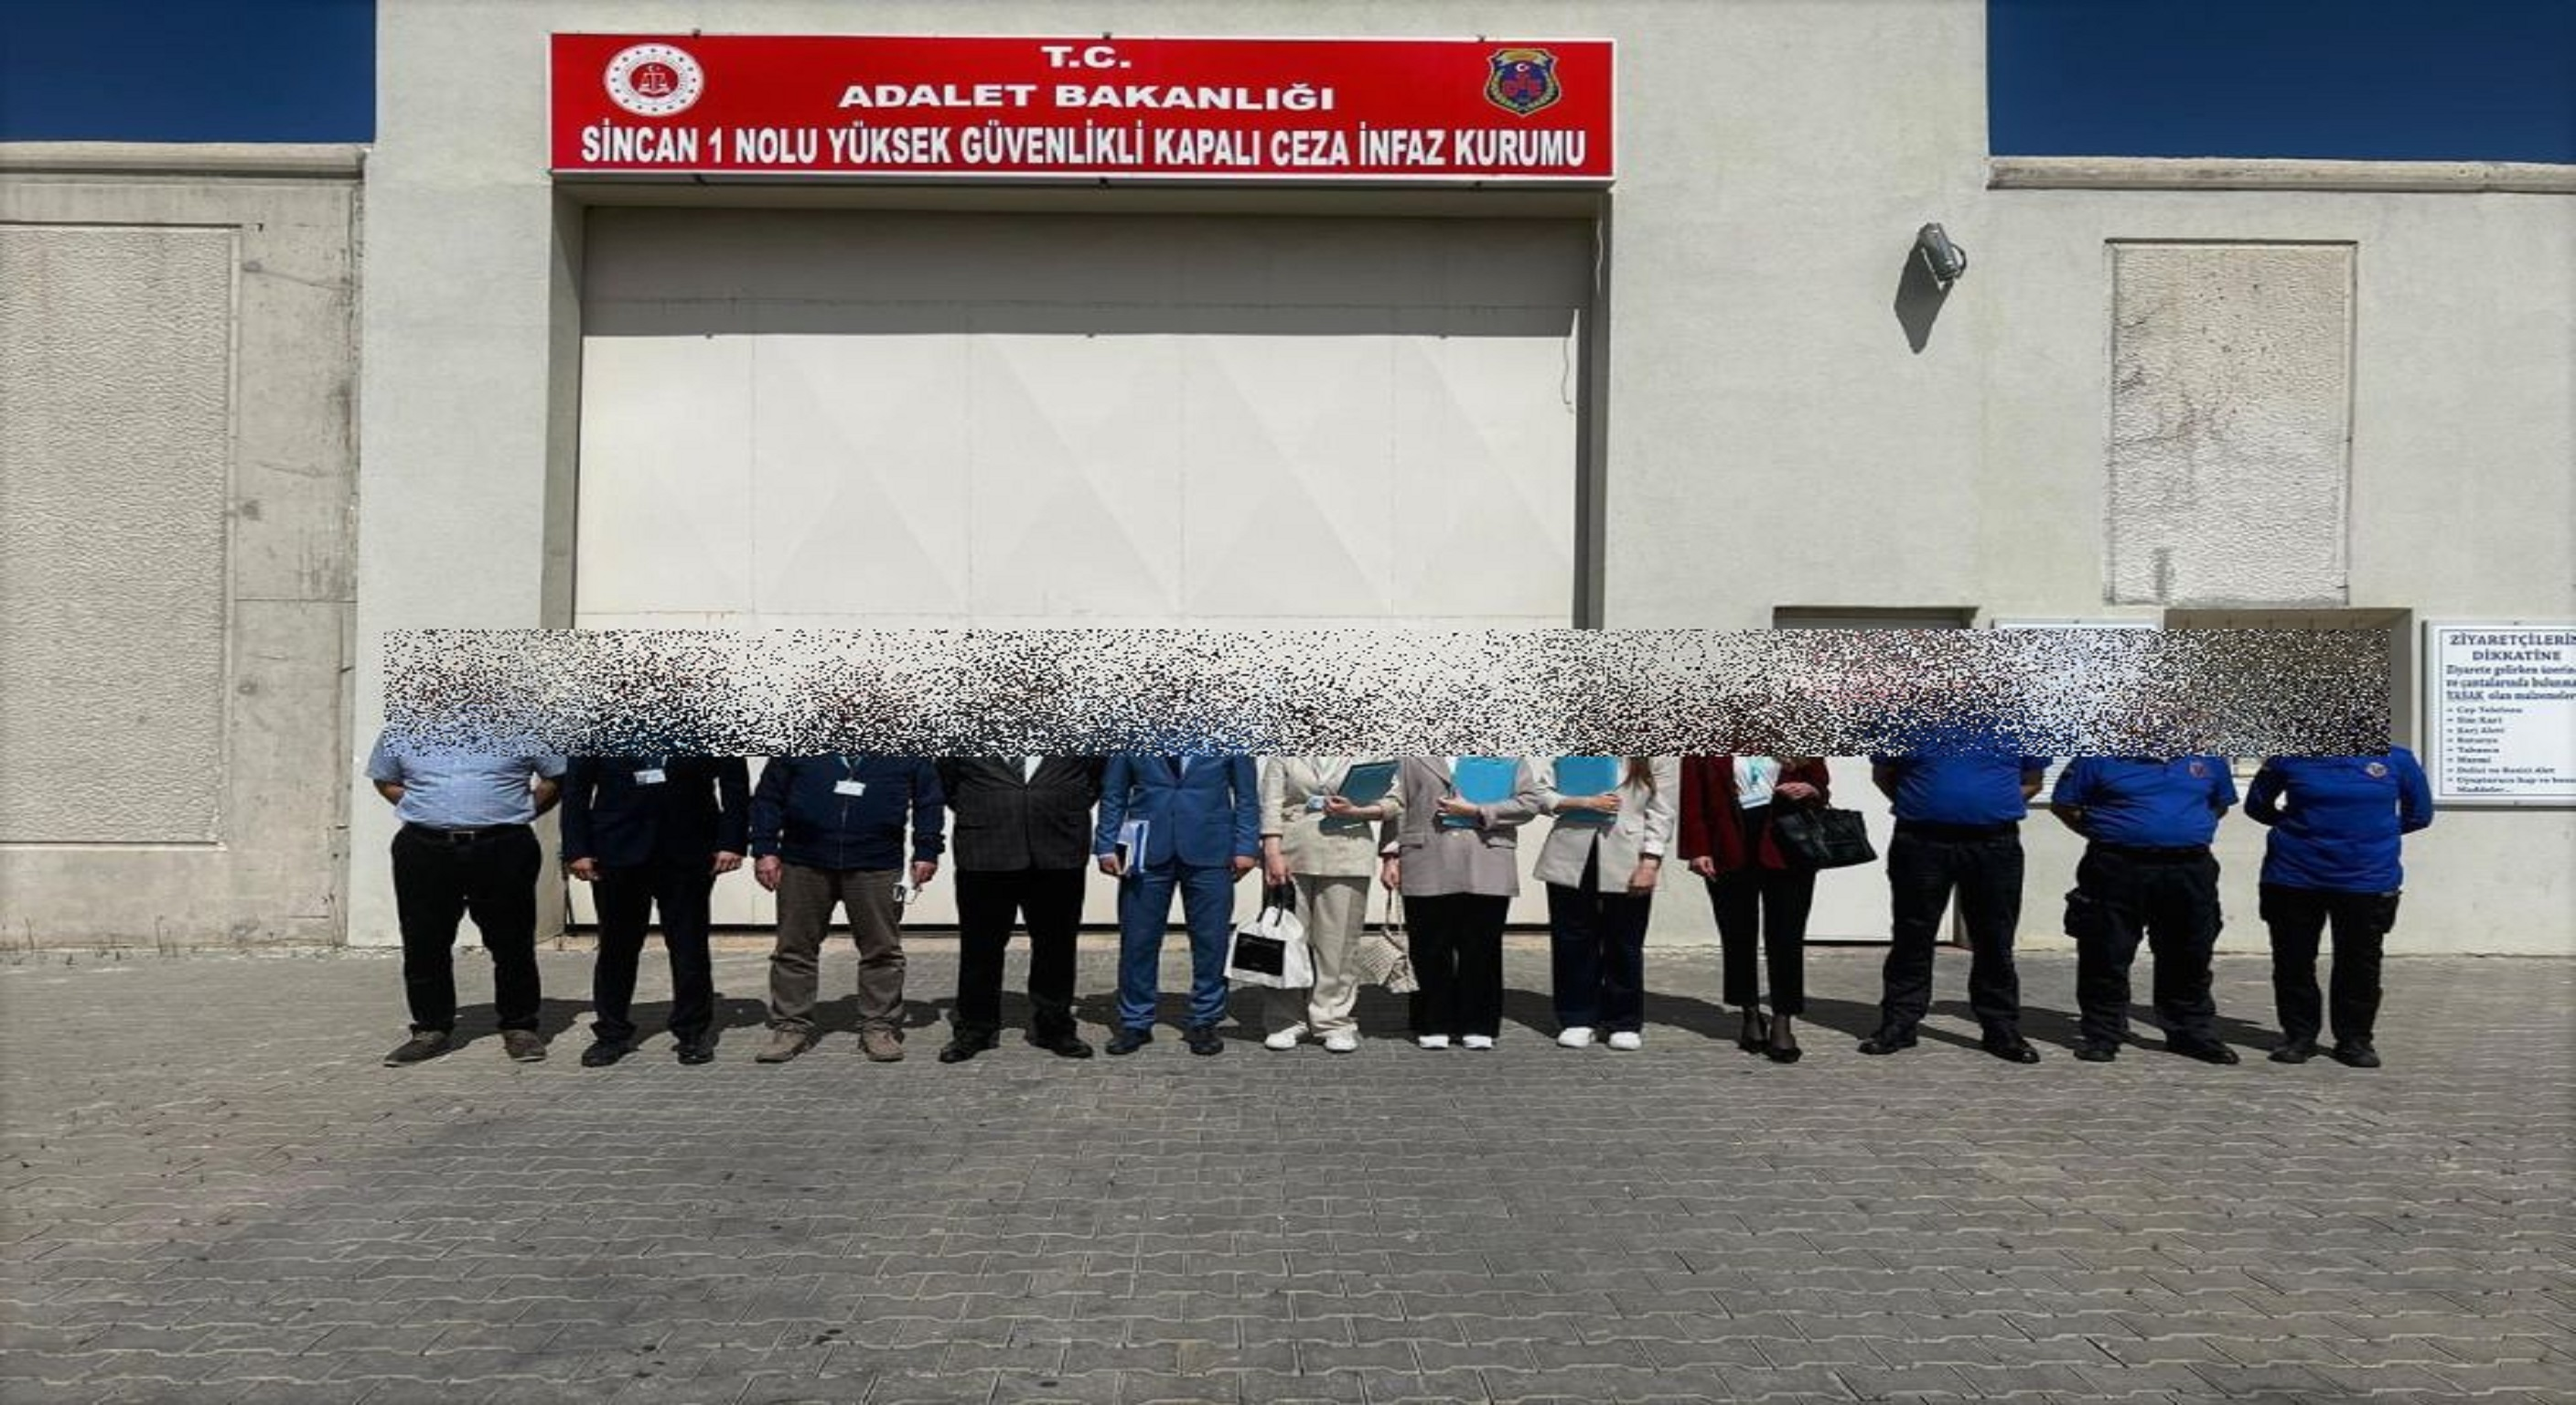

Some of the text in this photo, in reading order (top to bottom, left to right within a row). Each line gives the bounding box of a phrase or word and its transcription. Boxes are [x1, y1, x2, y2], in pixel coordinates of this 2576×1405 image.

[1041, 46, 1132, 69] T.C.
[838, 82, 1334, 111] ADALET BAKANLIĞI
[581, 118, 1586, 166] SİNCAN 1 NOLU YÜKSEK GÜVENLİKLİ KAPALI CEZA İNFAZ KURUMU
[2472, 649, 2562, 661] DİKKATİNE
